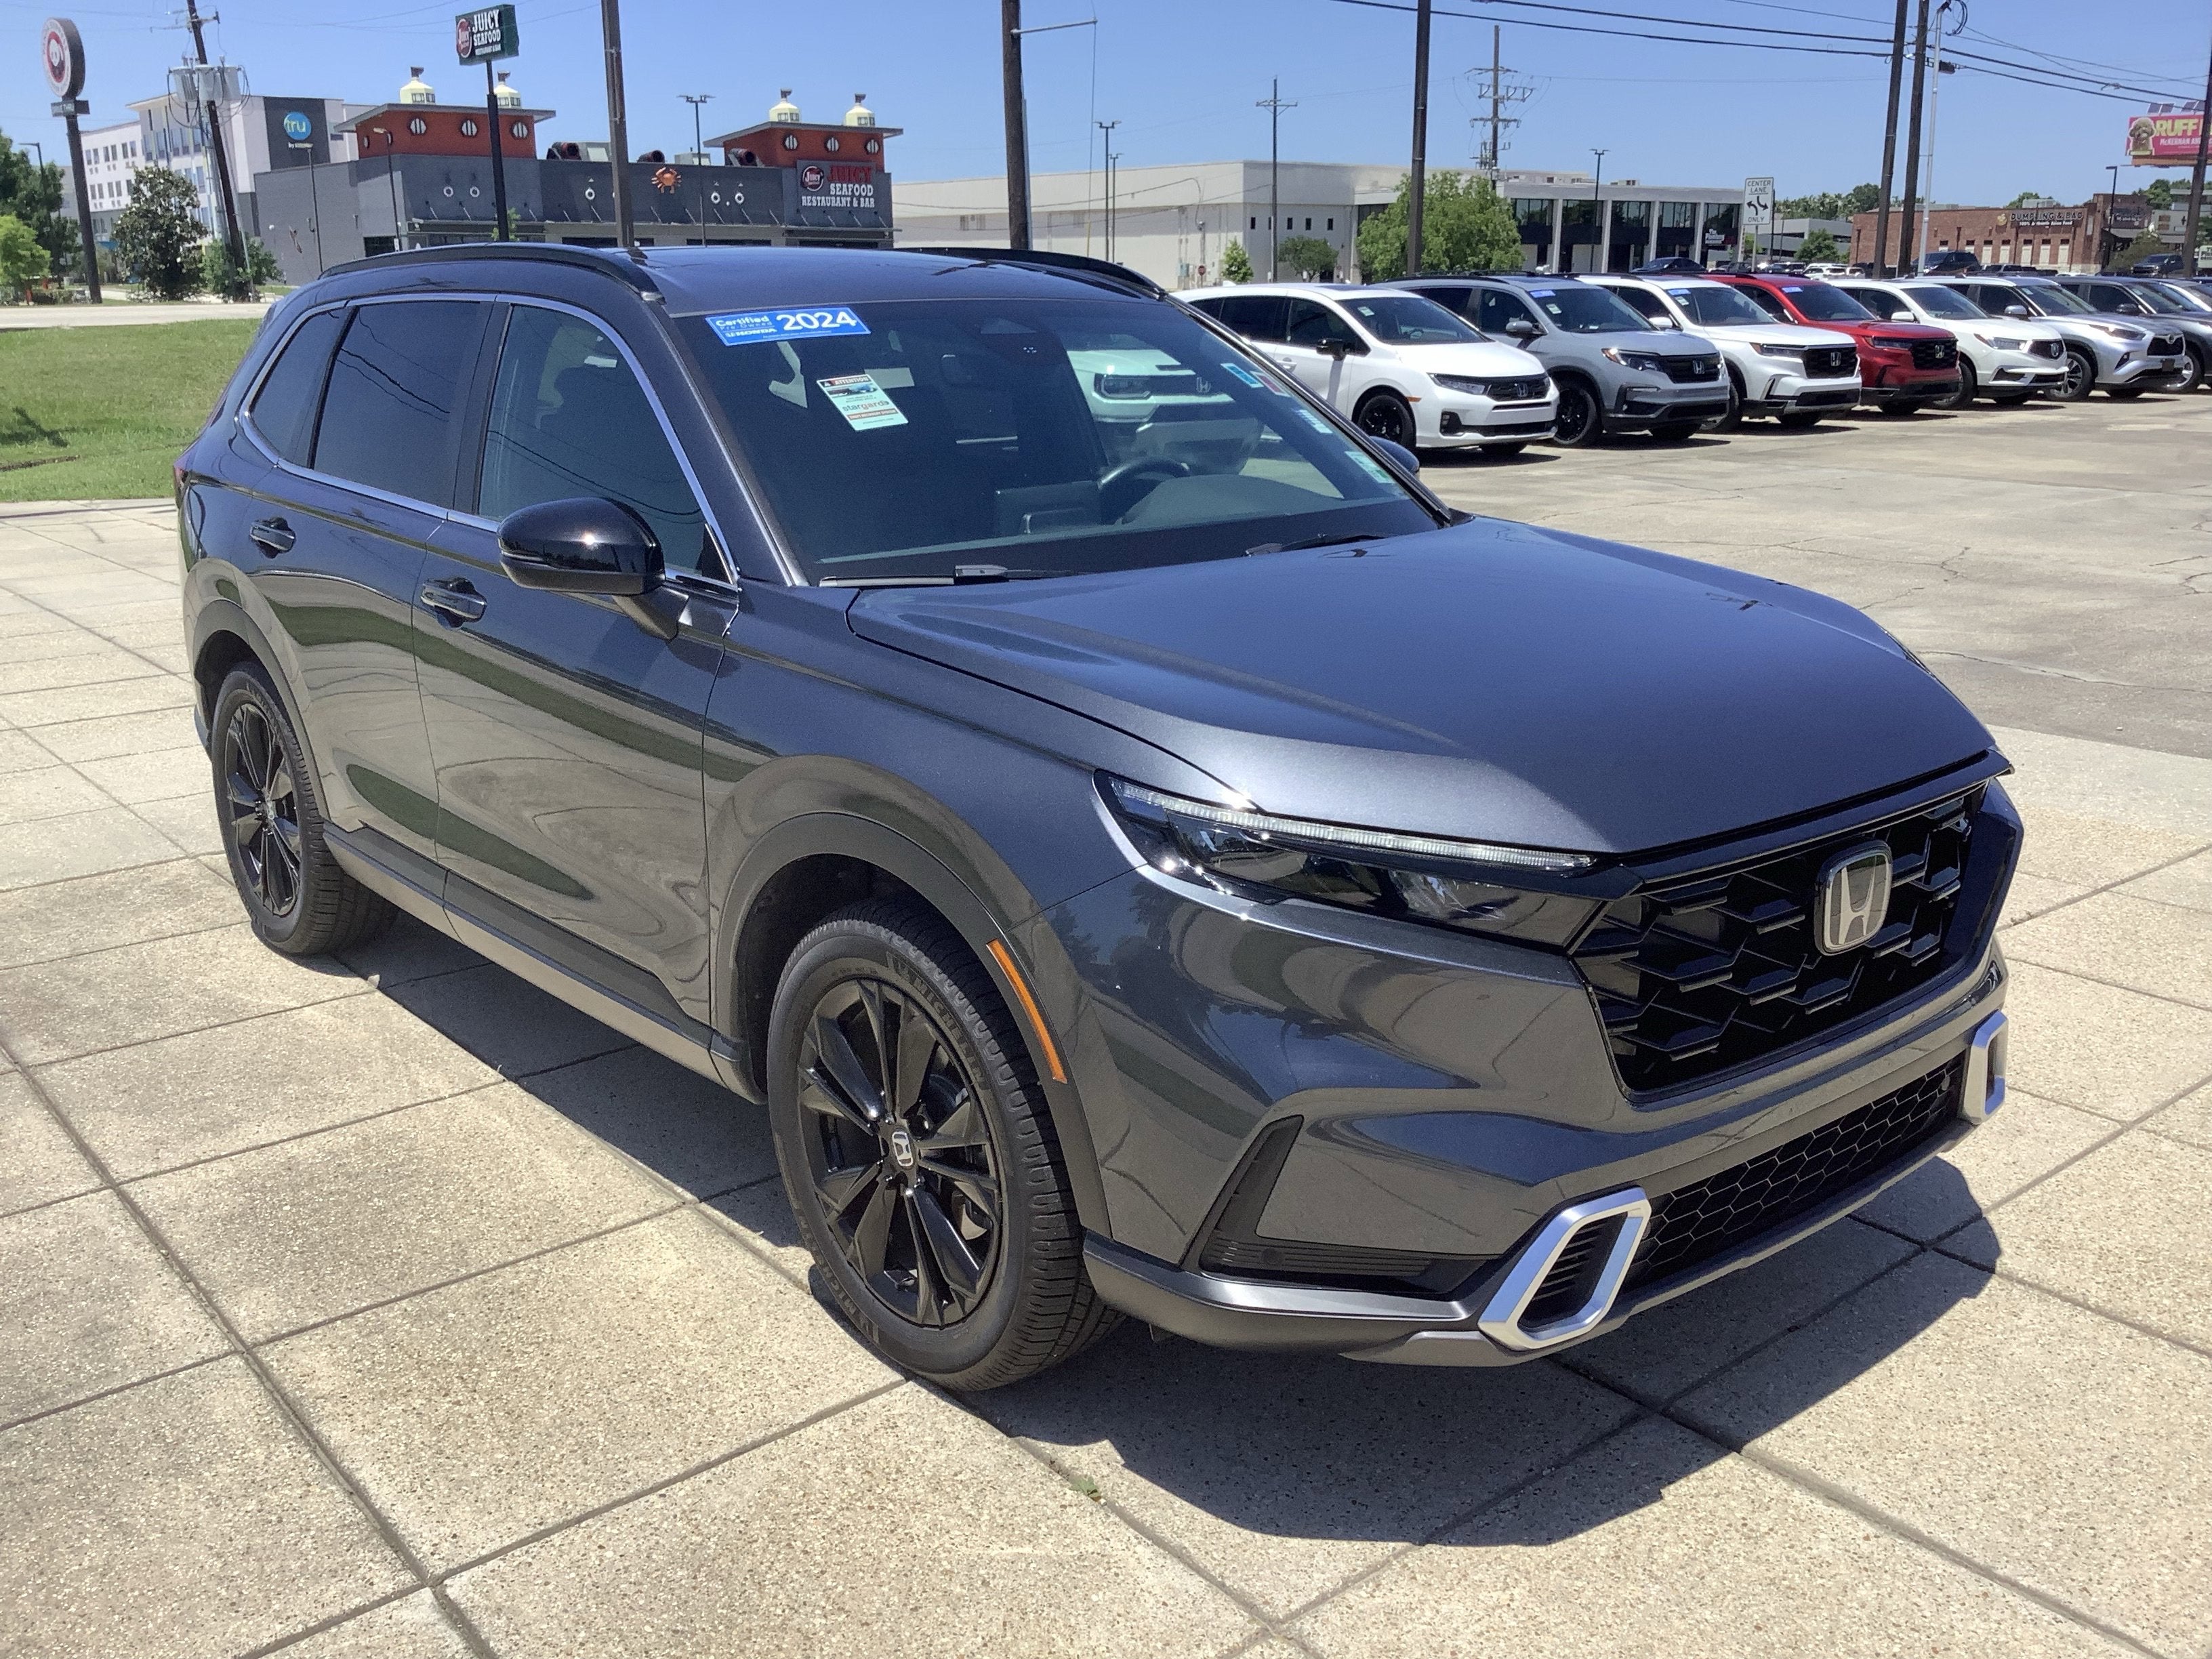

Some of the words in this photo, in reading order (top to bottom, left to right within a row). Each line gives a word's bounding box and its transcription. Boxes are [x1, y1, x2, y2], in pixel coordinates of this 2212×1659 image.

[472, 9, 499, 33] JUICY
[473, 28, 501, 46] SEAFOOD
[285, 119, 306, 133] tru
[2154, 119, 2199, 136] RUFF
[827, 166, 872, 183] JUICY
[830, 183, 874, 197] SEAFOOD
[801, 195, 851, 207] RESTAURANT
[859, 197, 875, 208] BAR
[2010, 212, 2055, 221] DUMPING
[716, 315, 770, 327] Certified
[776, 311, 857, 331] 2024
[735, 328, 778, 337] HONDA
[834, 376, 869, 386] ATTENTION
